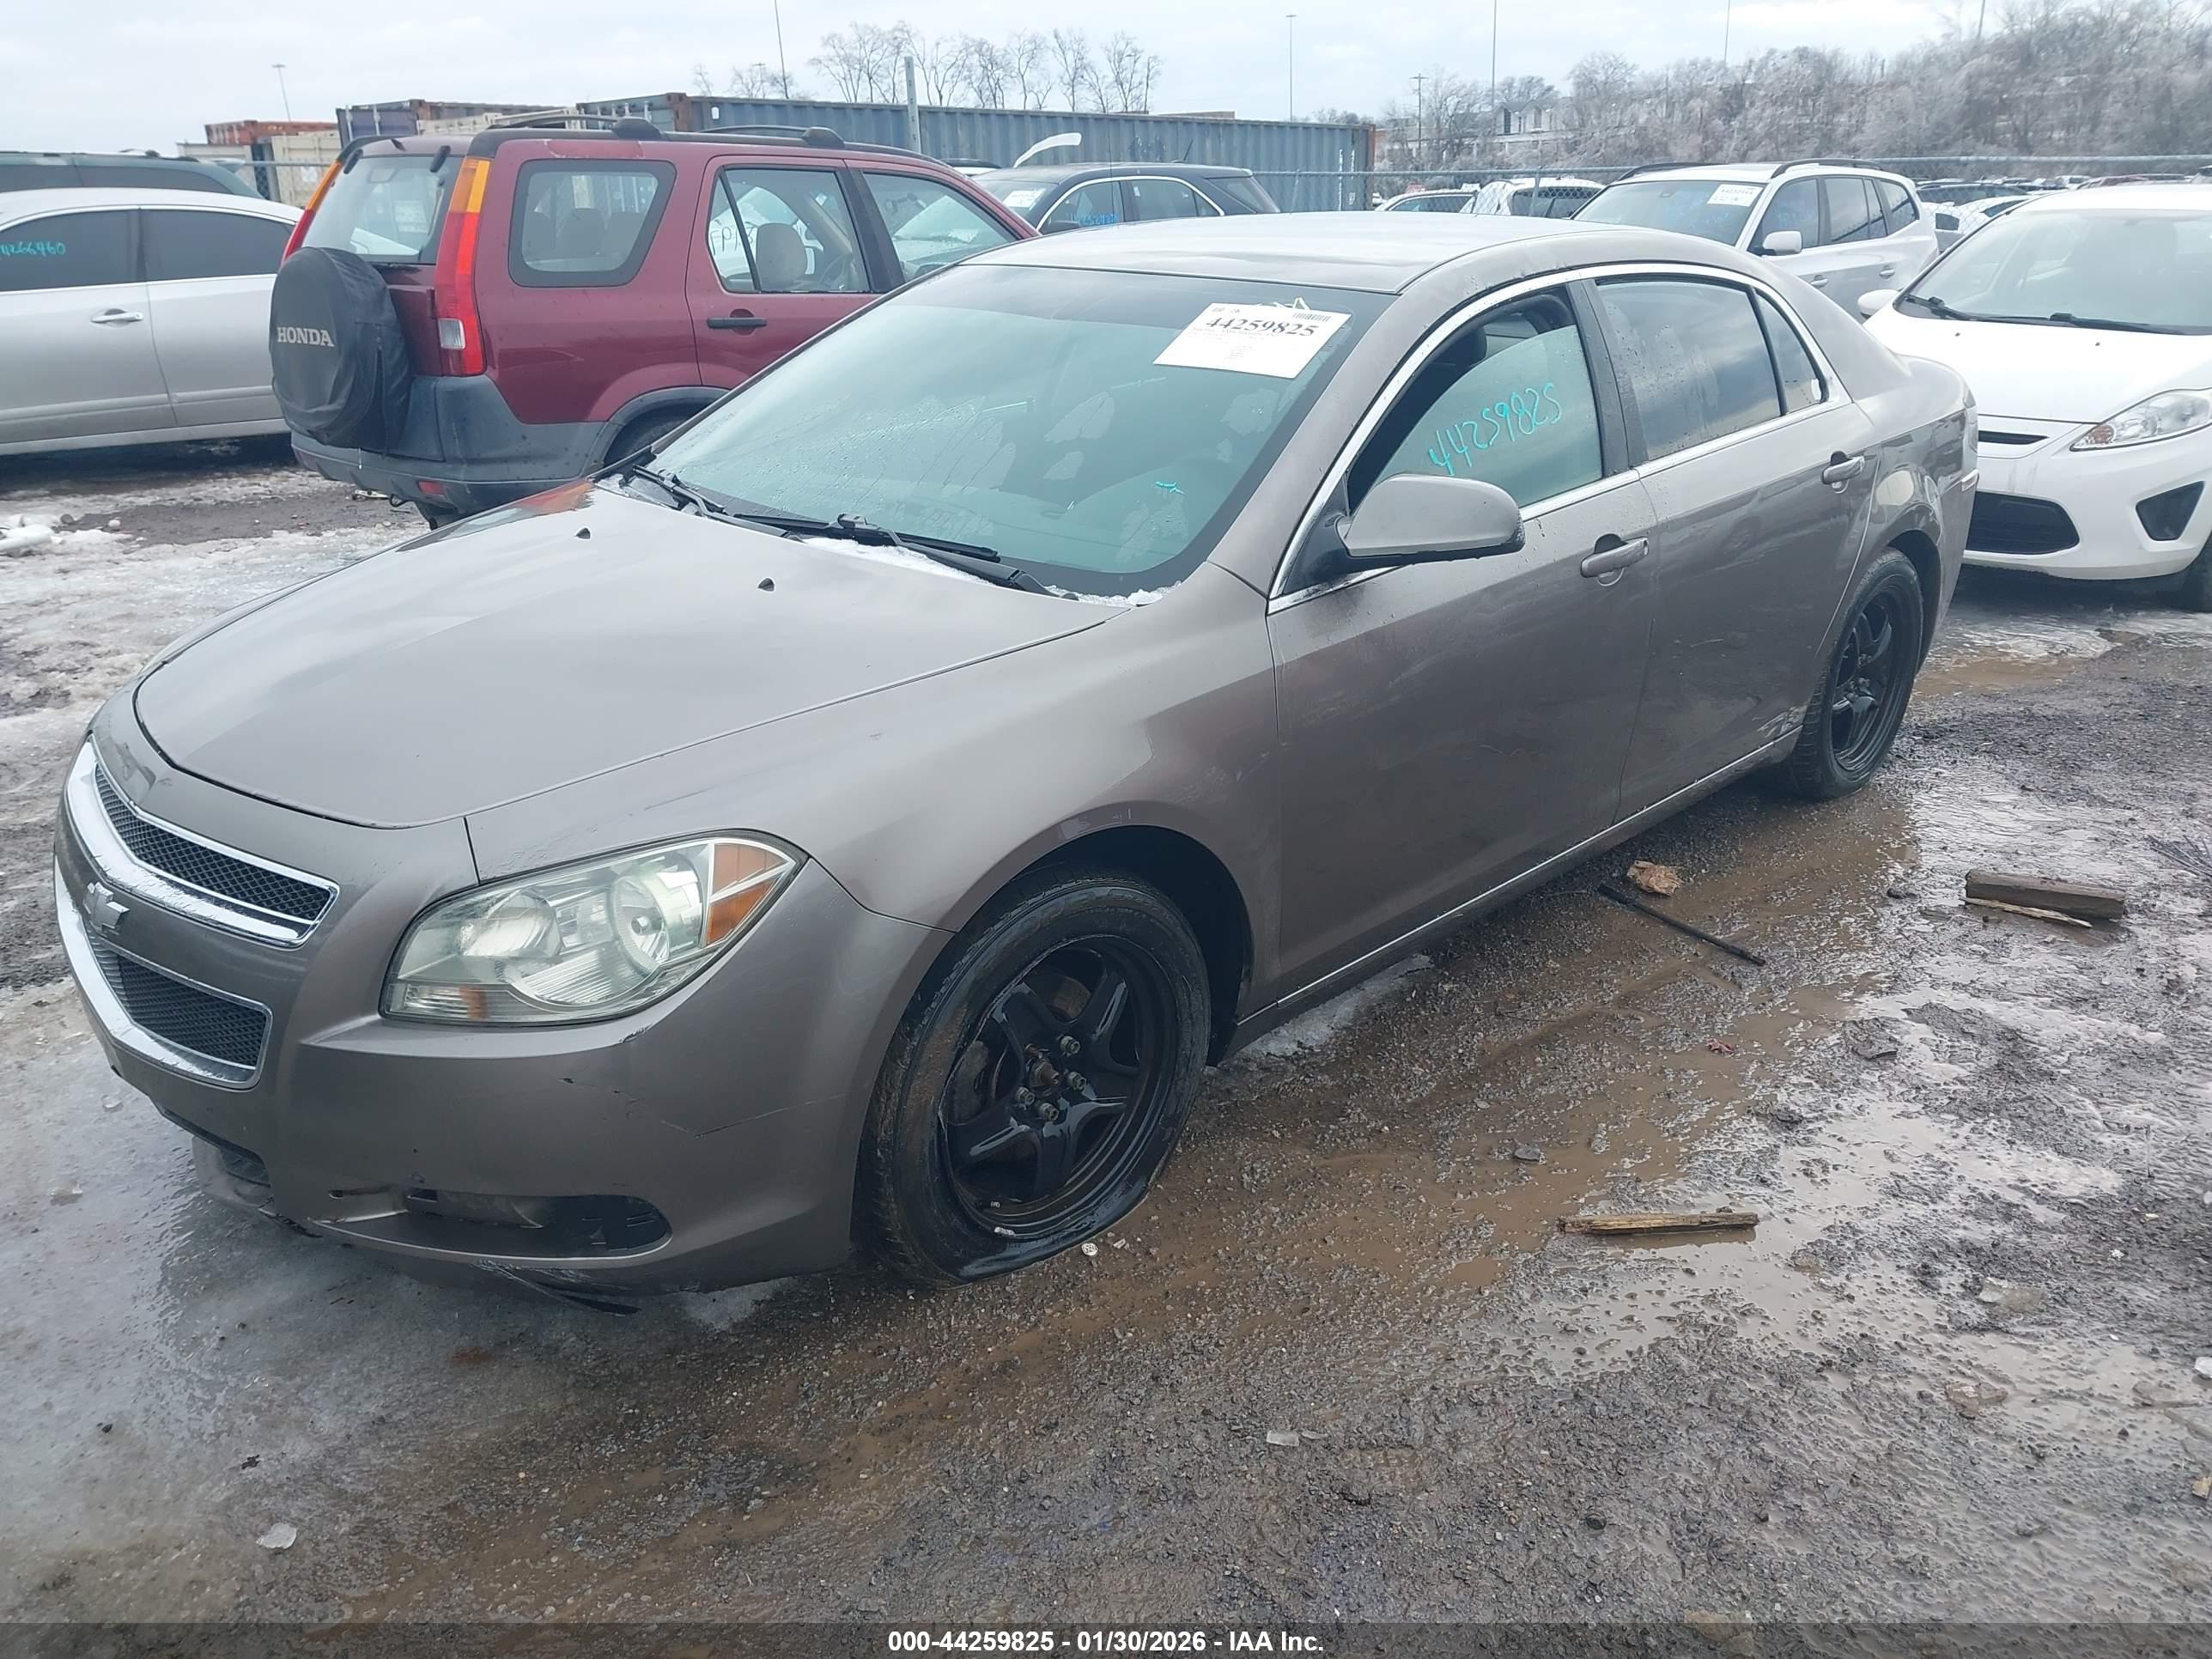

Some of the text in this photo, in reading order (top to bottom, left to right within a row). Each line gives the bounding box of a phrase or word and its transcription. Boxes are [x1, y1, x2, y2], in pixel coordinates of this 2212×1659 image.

[276, 326, 335, 347] HONDA
[1206, 317, 1320, 337] 44259825
[1428, 382, 1562, 477] 44259825
